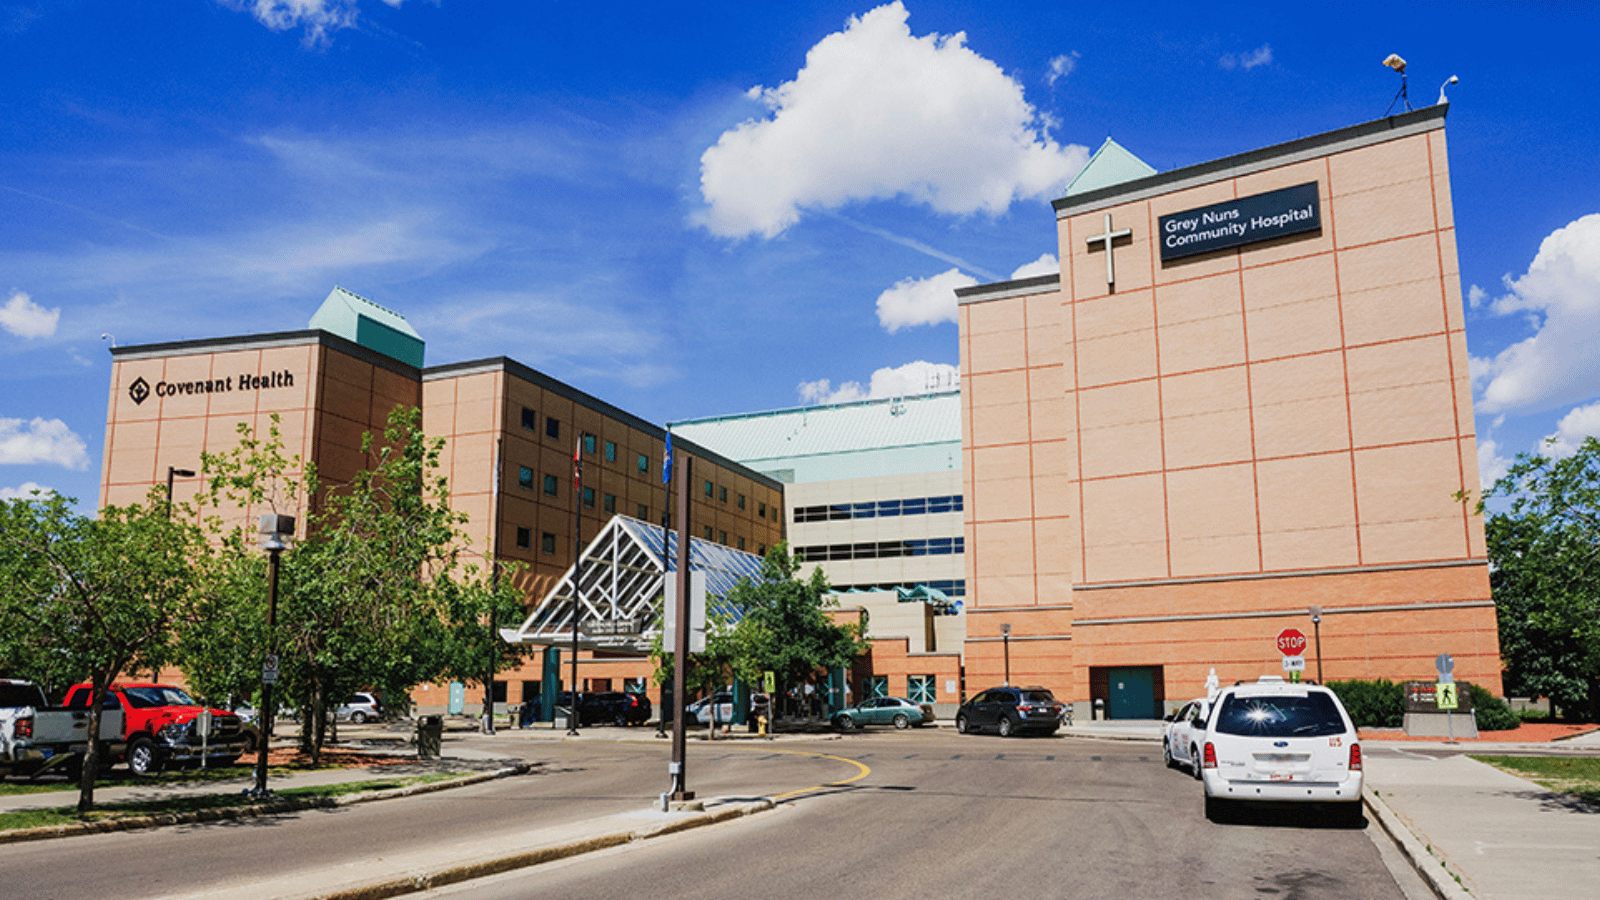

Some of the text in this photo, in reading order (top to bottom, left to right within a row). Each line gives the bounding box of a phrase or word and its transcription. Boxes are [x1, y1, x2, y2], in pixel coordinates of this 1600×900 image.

[1165, 208, 1240, 233] Grey Nuns
[1165, 204, 1313, 248] Community Hospital
[155, 369, 294, 397] Covenant Health
[1278, 636, 1305, 649] STOP
